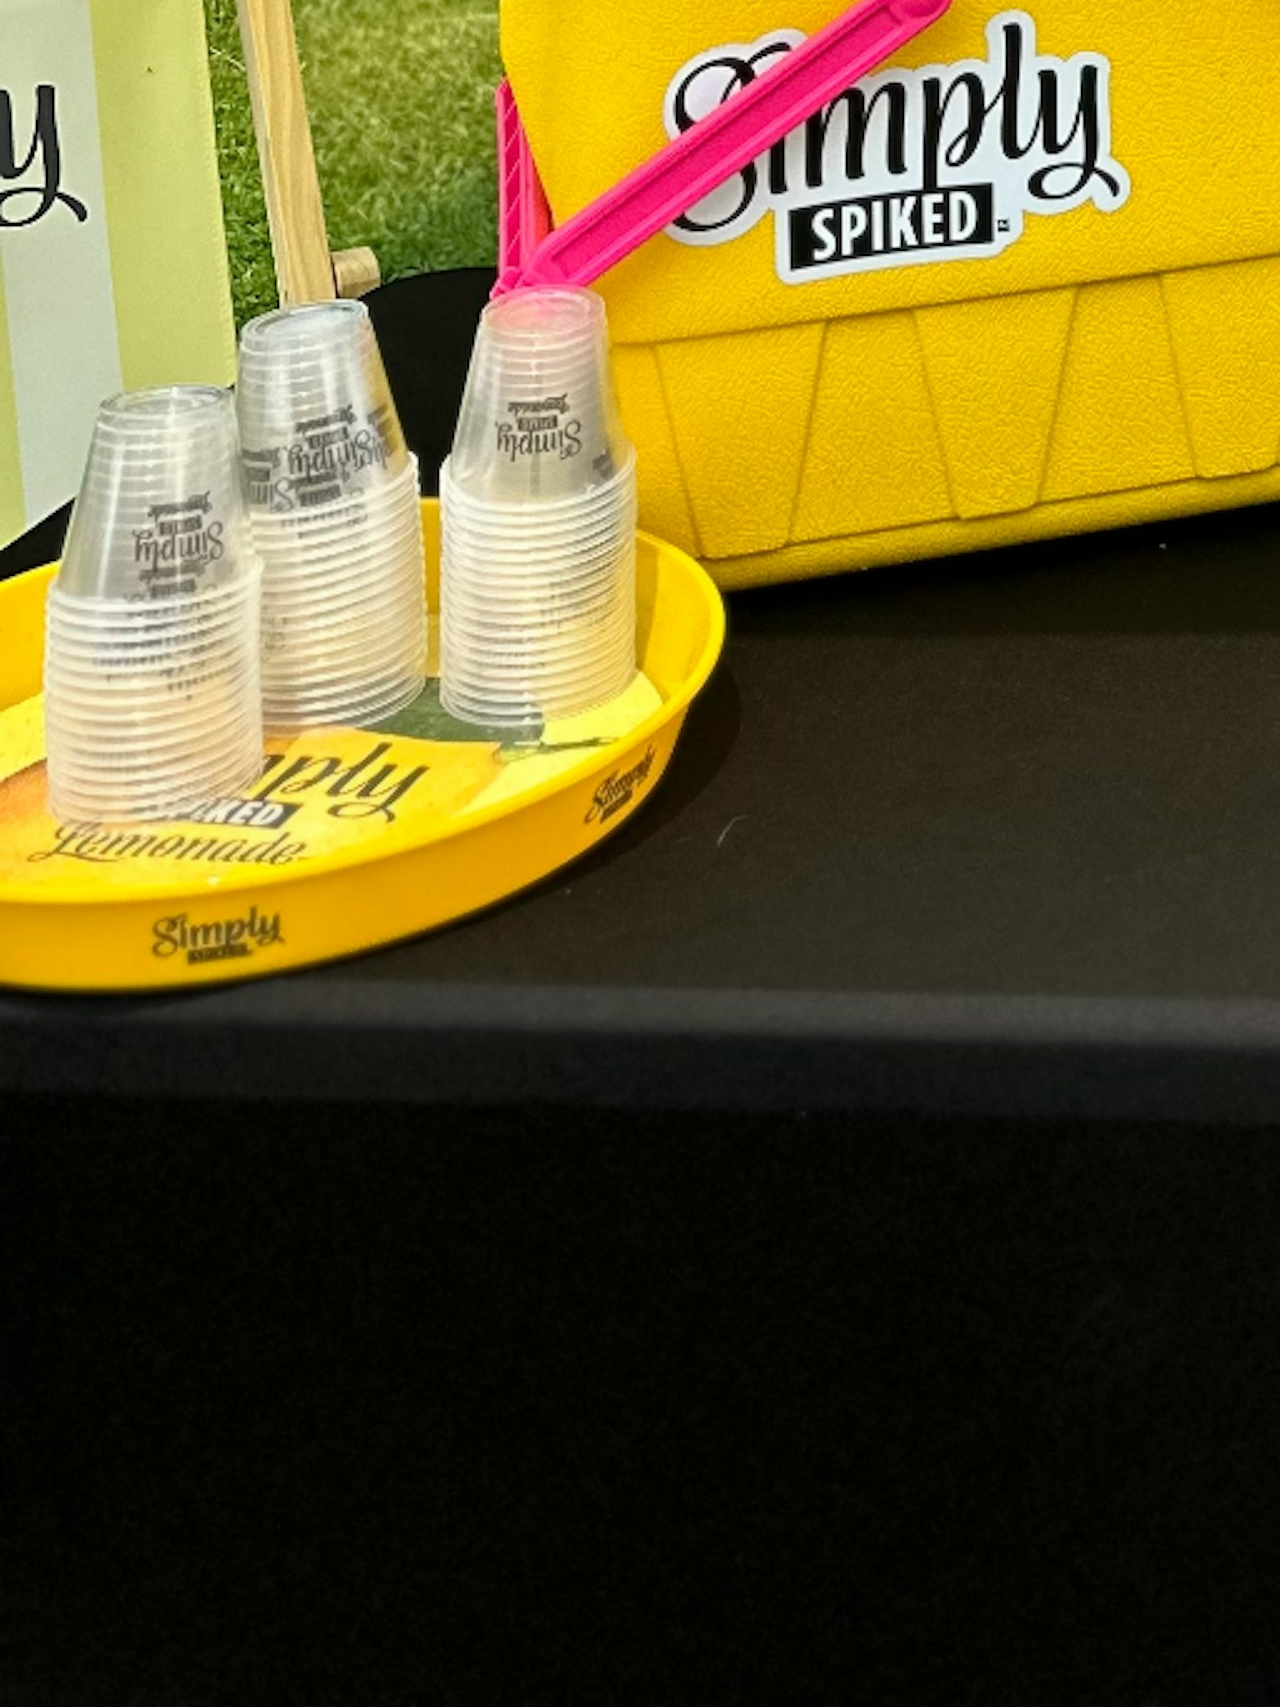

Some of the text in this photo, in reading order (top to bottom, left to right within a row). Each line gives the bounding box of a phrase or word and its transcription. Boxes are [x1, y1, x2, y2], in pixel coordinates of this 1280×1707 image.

[811, 190, 979, 262] SPIKED
[495, 419, 583, 464] Simply
[152, 905, 285, 958] Simply
